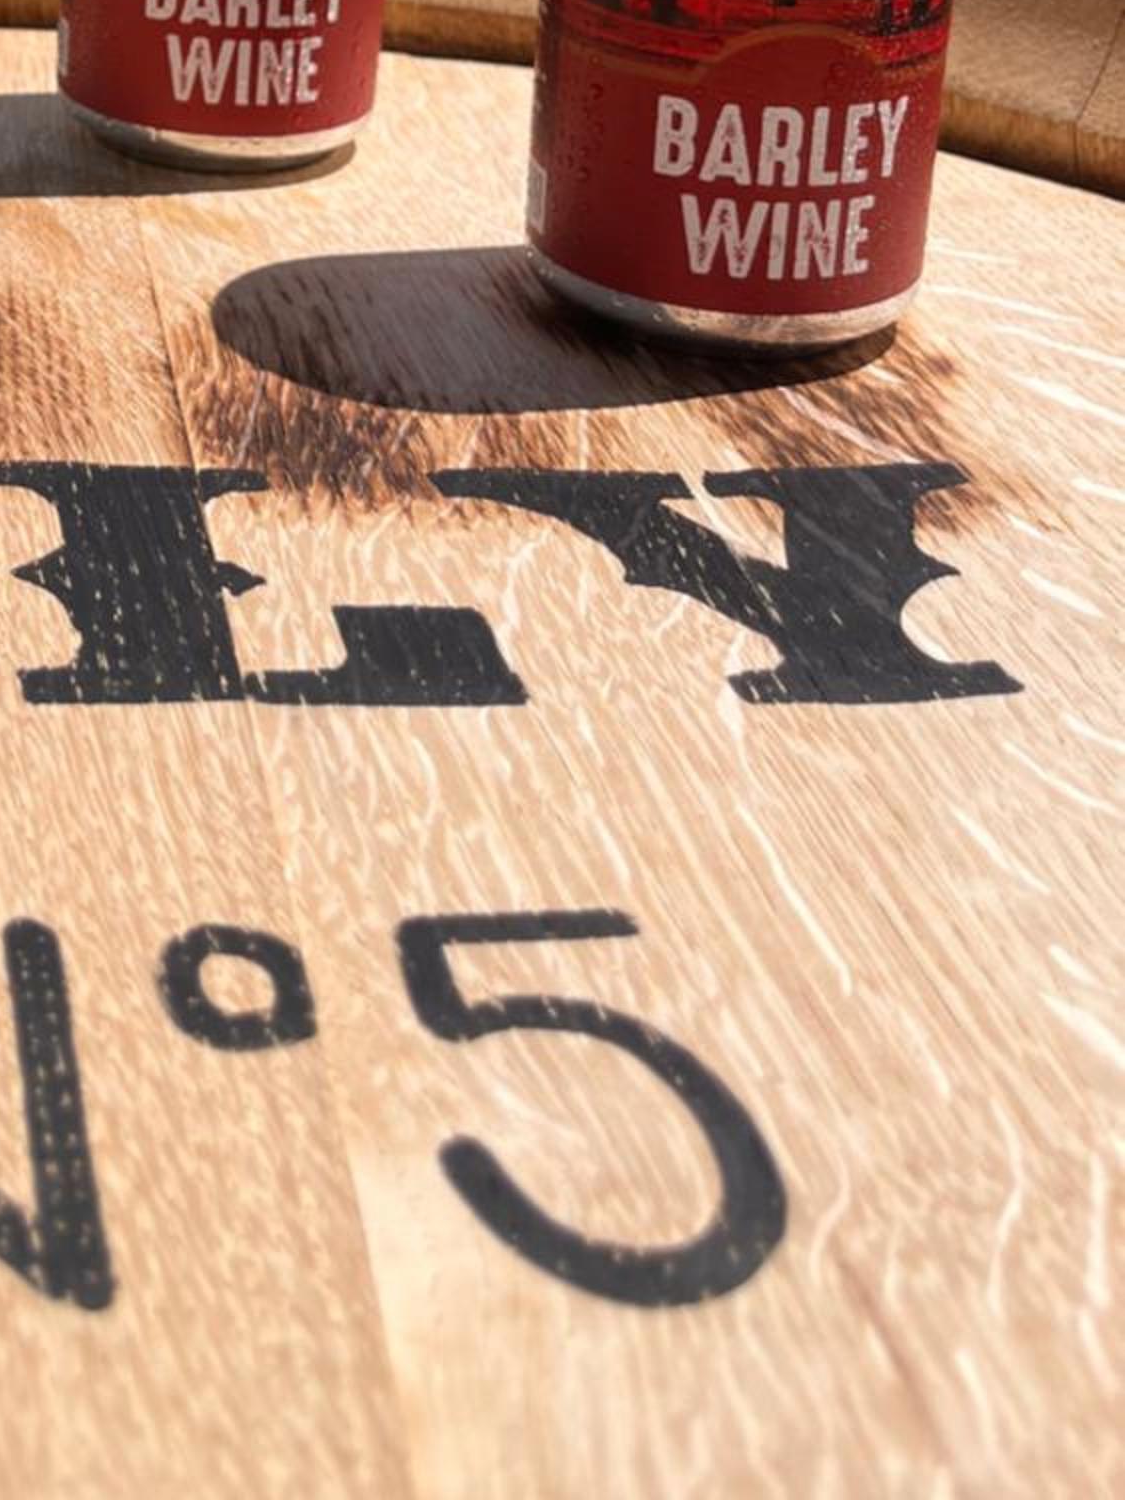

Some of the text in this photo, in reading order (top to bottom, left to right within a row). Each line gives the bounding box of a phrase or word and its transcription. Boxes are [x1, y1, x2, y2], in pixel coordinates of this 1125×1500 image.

[166, 34, 323, 106] WINE
[652, 94, 909, 188] BARLEY
[680, 193, 875, 280] WINE
[395, 909, 788, 1310] 5
